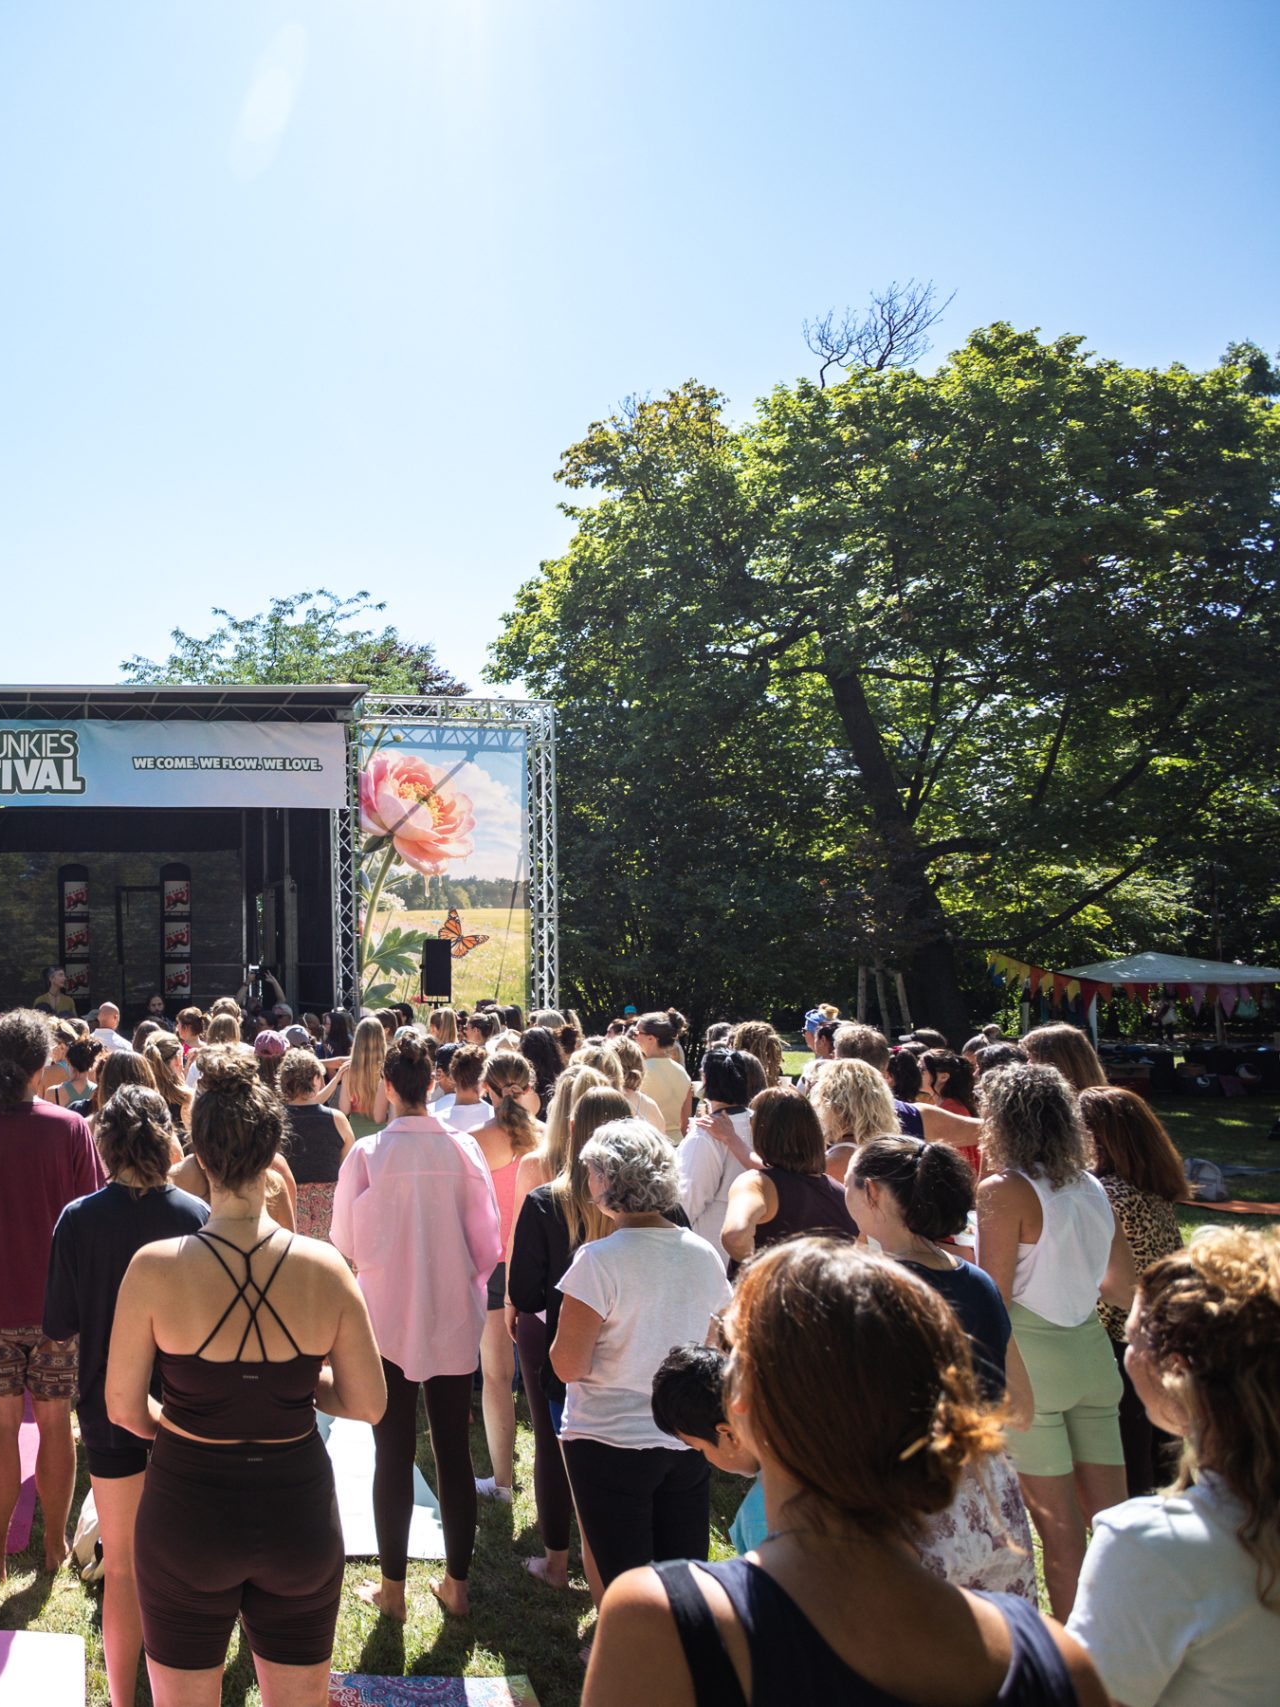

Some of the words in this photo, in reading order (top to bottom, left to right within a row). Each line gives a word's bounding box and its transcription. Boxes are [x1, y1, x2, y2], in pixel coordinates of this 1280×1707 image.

[133, 757, 154, 769] WE
[156, 757, 198, 769] COME.
[199, 757, 220, 769] WE
[222, 757, 261, 770] FLOW.
[263, 758, 283, 770] WE
[285, 758, 322, 771] LOVE.
